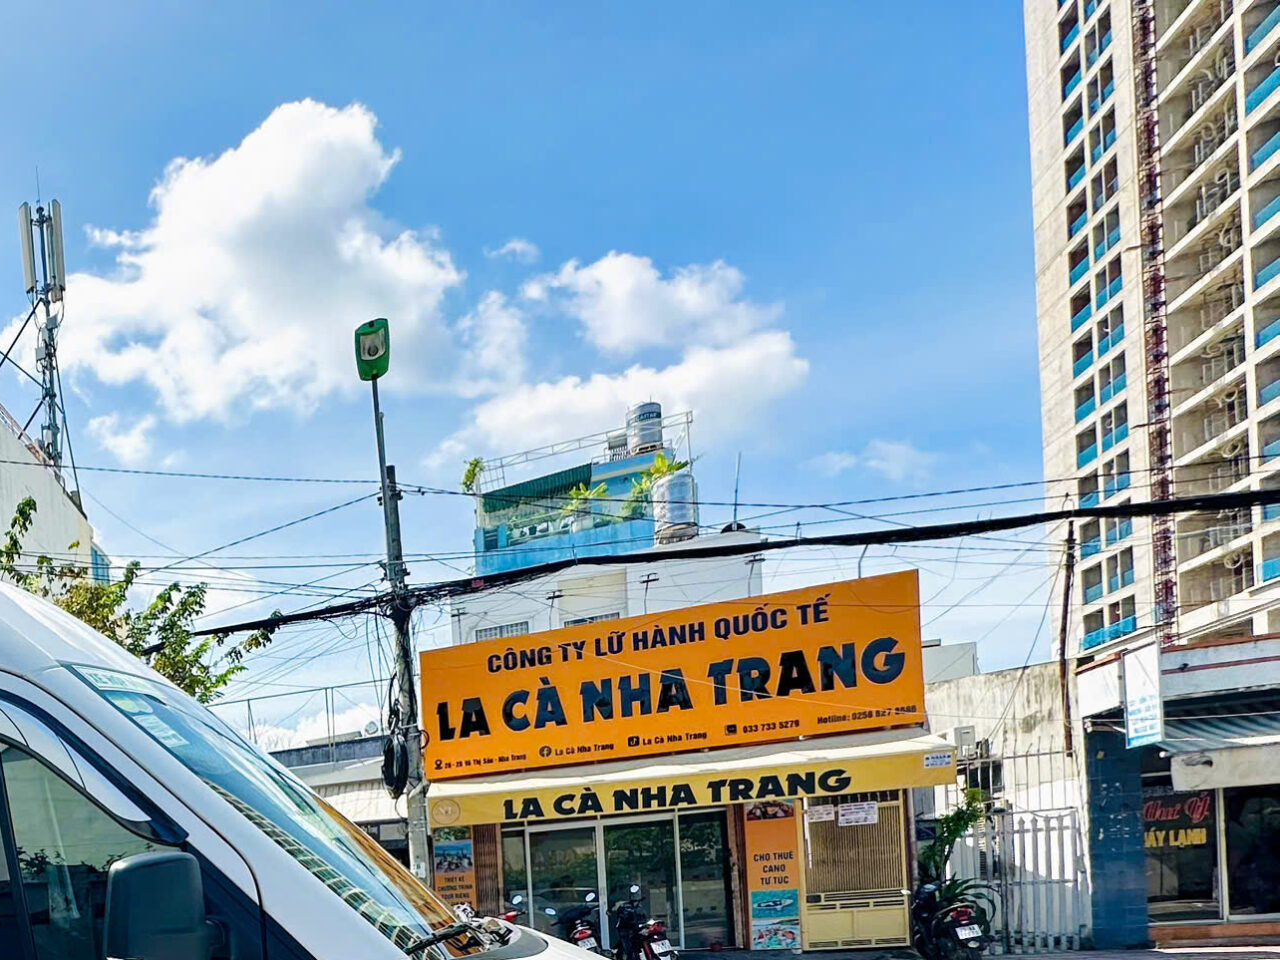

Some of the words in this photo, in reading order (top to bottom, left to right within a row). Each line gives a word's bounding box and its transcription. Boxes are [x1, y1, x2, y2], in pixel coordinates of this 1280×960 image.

[487, 643, 553, 673] CÔNG
[558, 640, 587, 663] TY
[632, 620, 706, 652] HÀNH
[714, 603, 788, 641] QUỐC
[796, 593, 832, 625] TẾ
[436, 696, 491, 742] LA
[502, 676, 568, 732] CÀ
[578, 668, 694, 723] NHA
[707, 636, 906, 707] TRANG
[642, 738, 653, 746] La
[667, 733, 683, 743] Nha
[685, 731, 707, 742] Trang
[577, 745, 592, 753] Nha
[593, 743, 614, 752] Trang
[504, 797, 544, 820] LA
[552, 786, 604, 816] CÀ
[613, 783, 698, 812] NHA
[707, 768, 852, 803] TRANG
[753, 853, 770, 862] CHO
[762, 864, 786, 873] CANO
